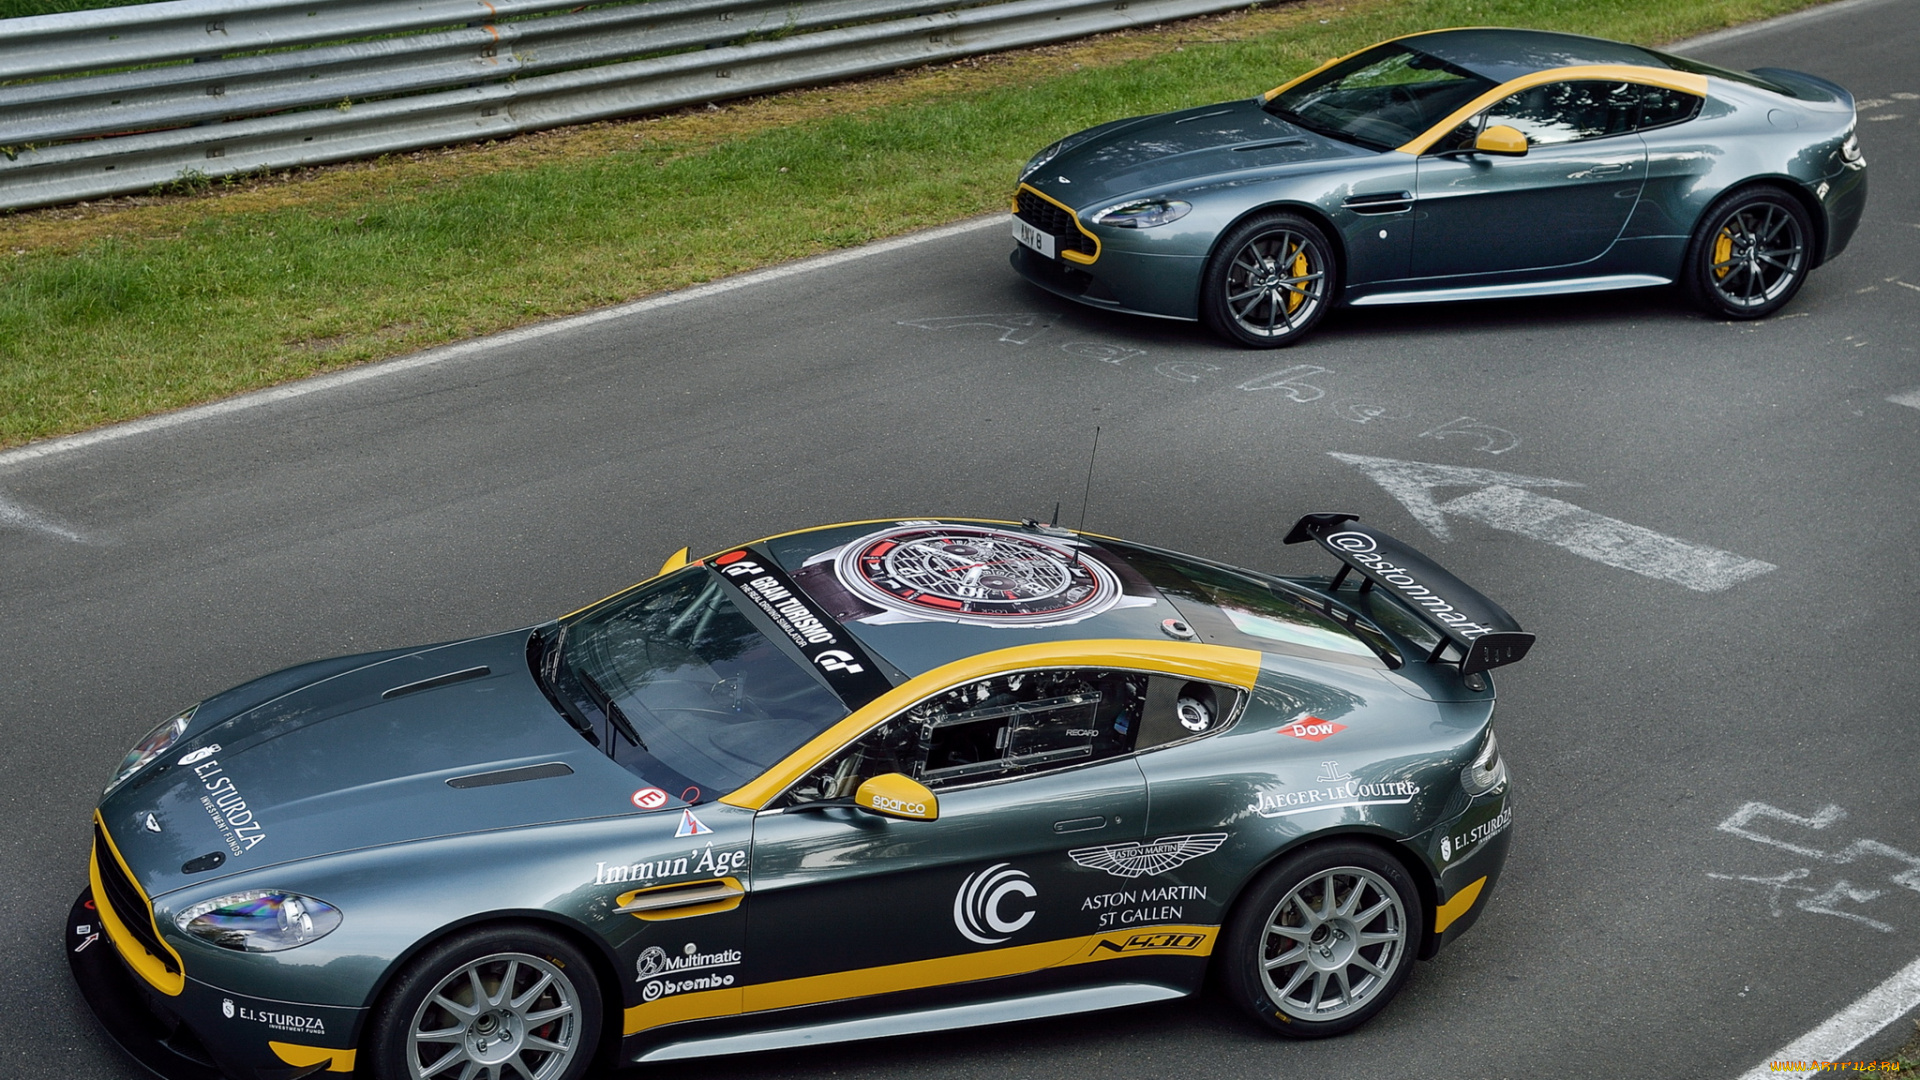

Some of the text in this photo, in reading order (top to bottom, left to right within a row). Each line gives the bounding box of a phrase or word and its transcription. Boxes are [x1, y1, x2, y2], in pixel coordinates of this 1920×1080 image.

[1036, 232, 1042, 250] 8
[750, 576, 792, 602] GRAN
[1326, 531, 1493, 640] @astonmart
[759, 600, 781, 624] DRIVING
[776, 617, 808, 648] SIMULATOR
[205, 777, 266, 851] STURDZA
[872, 795, 926, 815] sparco
[200, 795, 243, 857] INVESTMENT FUNDS
[1470, 806, 1512, 842] STURDZA
[1115, 844, 1178, 859] ASTON MARTIN
[1081, 886, 1207, 911] ASTON MARTIN
[1099, 906, 1183, 926] ST GALLEN
[1088, 934, 1206, 957] N430
[665, 949, 742, 971] Multimatic
[664, 973, 735, 995] brembo
[259, 1011, 325, 1030] STURDZA
[269, 1024, 304, 1033] INVESTMENT
